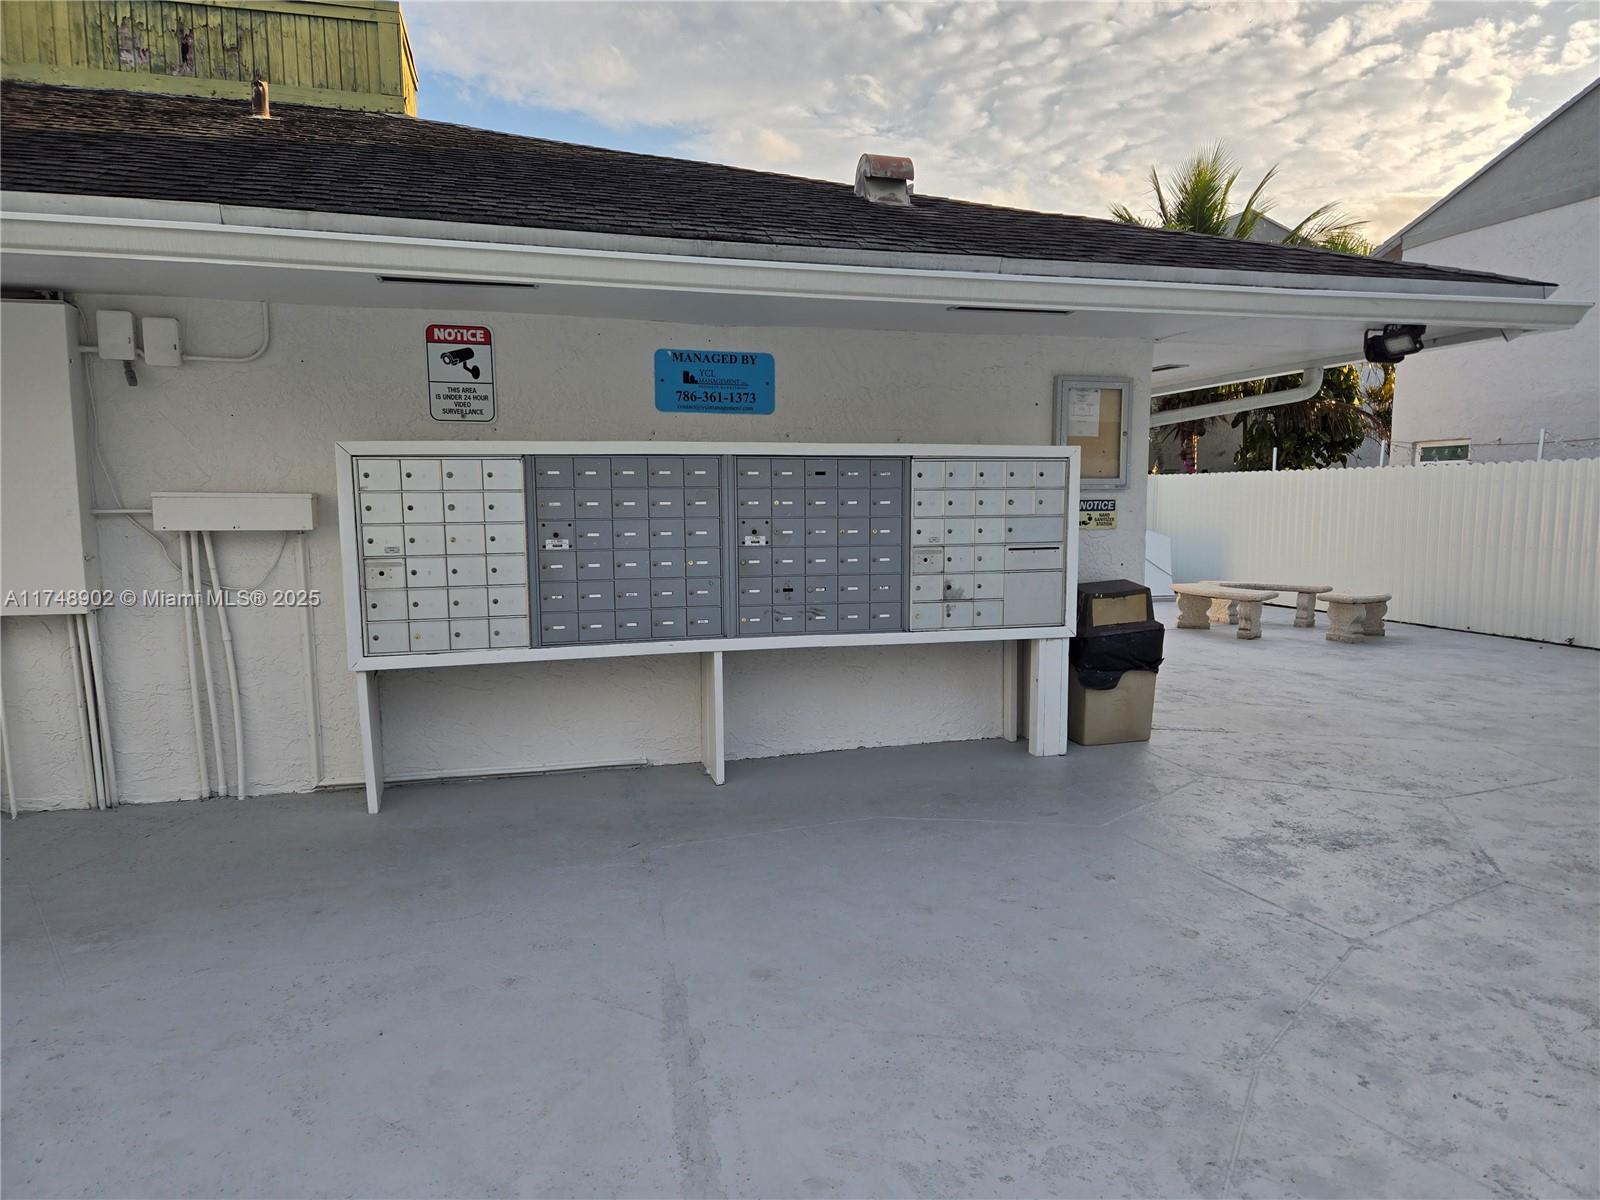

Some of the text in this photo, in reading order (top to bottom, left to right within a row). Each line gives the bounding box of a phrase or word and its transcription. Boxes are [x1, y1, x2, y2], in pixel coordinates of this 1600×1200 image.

[433, 328, 485, 342] NOTICE
[672, 352, 758, 365] MANAGED BY
[699, 369, 716, 377] YCL
[447, 386, 460, 394] THIS
[675, 390, 757, 404] 786-361-1373
[442, 408, 484, 416] SURVEILLANCE
[1079, 500, 1115, 510] NOTICE
